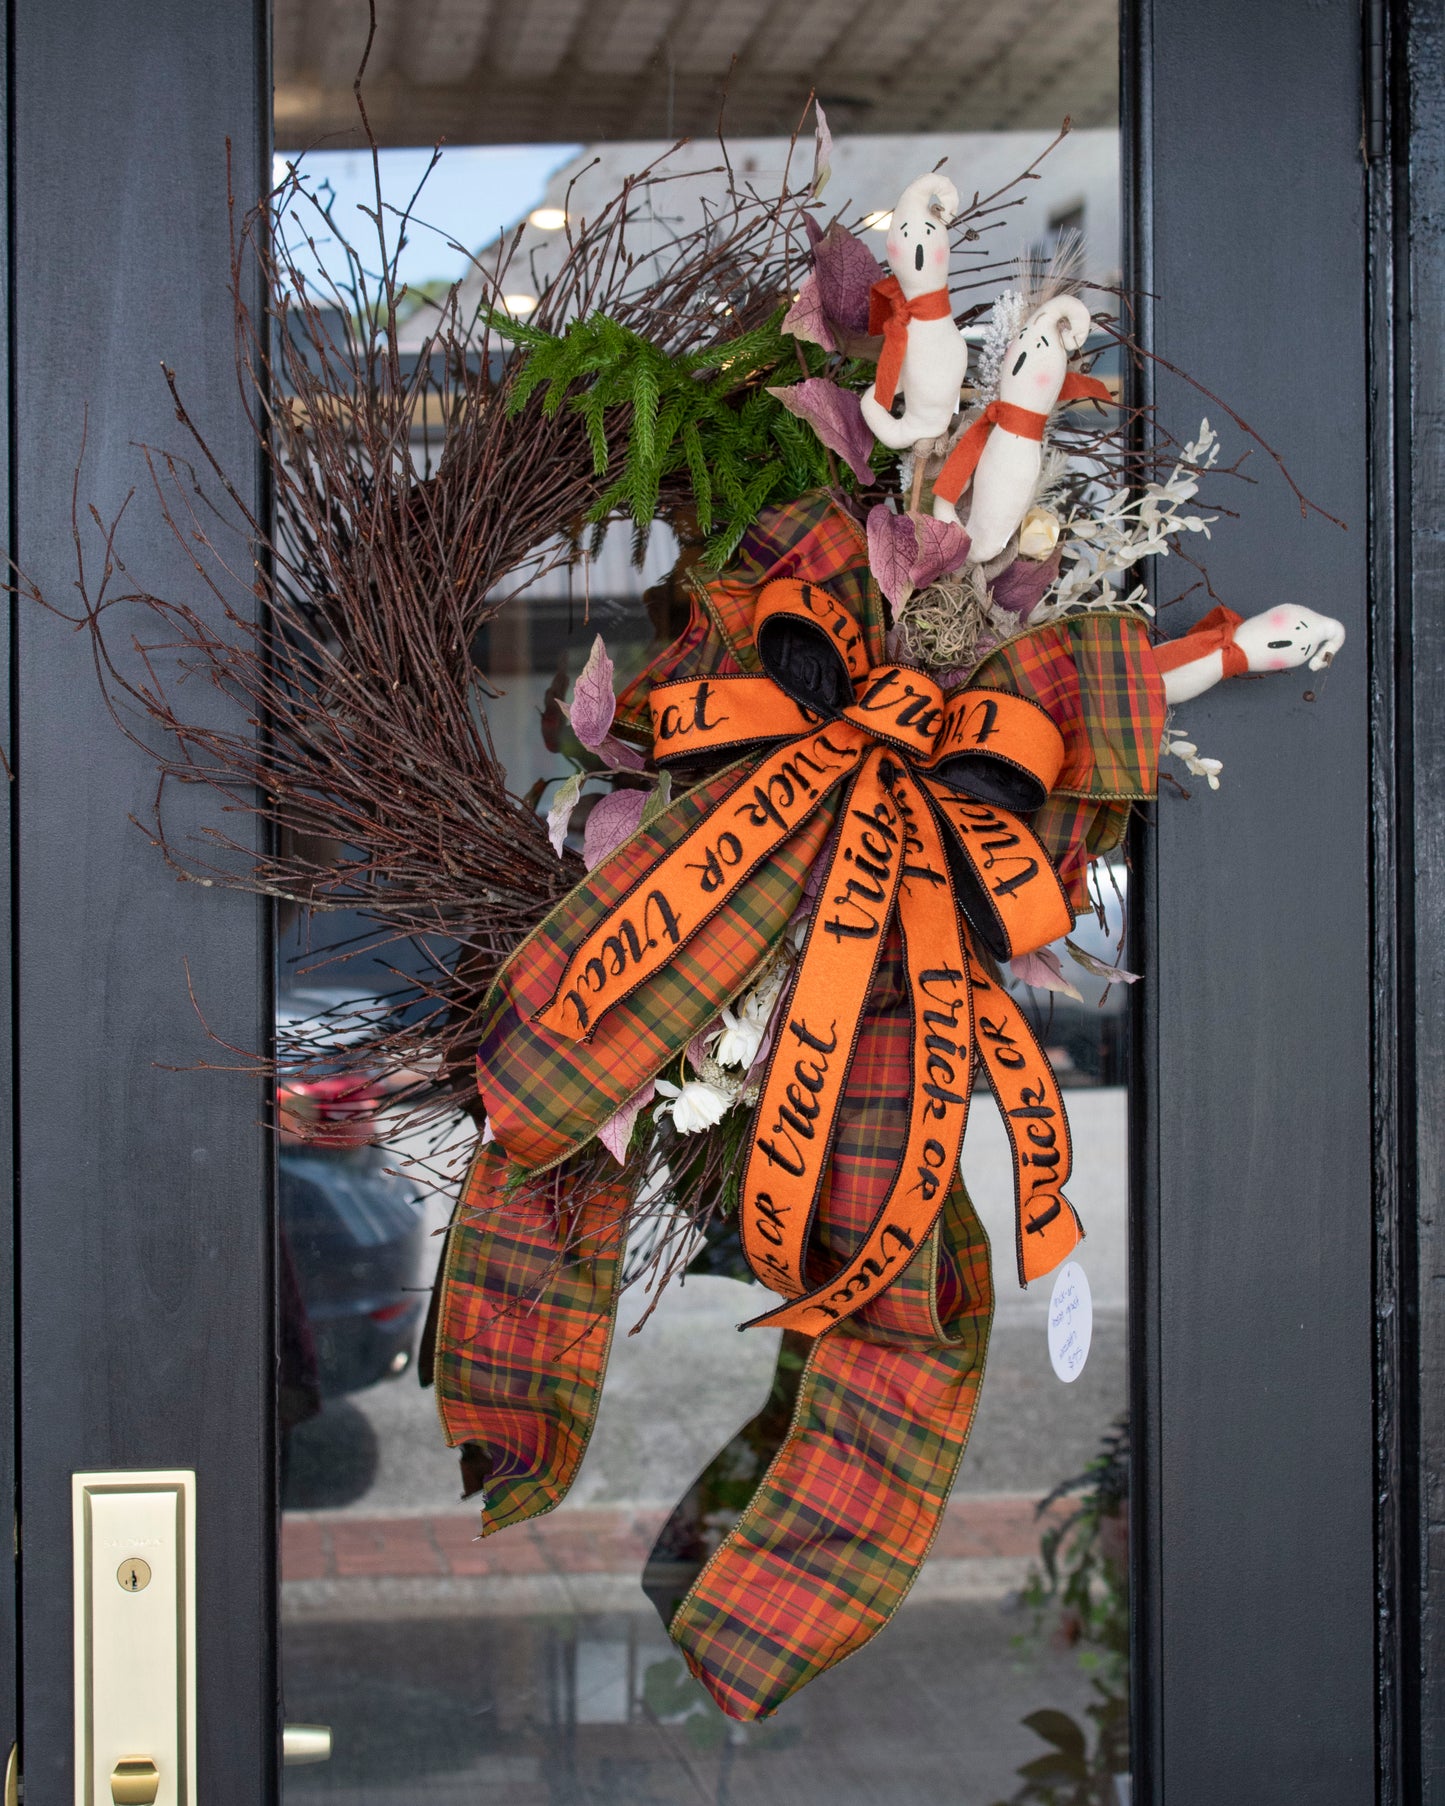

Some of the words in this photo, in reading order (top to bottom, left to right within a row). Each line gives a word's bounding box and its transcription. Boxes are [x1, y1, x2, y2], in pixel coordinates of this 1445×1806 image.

[734, 735, 858, 831] trick
[561, 890, 682, 1029] treat
[757, 1018, 838, 1177] treat
[824, 803, 899, 944] trick
[919, 961, 968, 1125] trick
[1009, 1077, 1060, 1237] trick
[802, 1224, 915, 1319] treat
